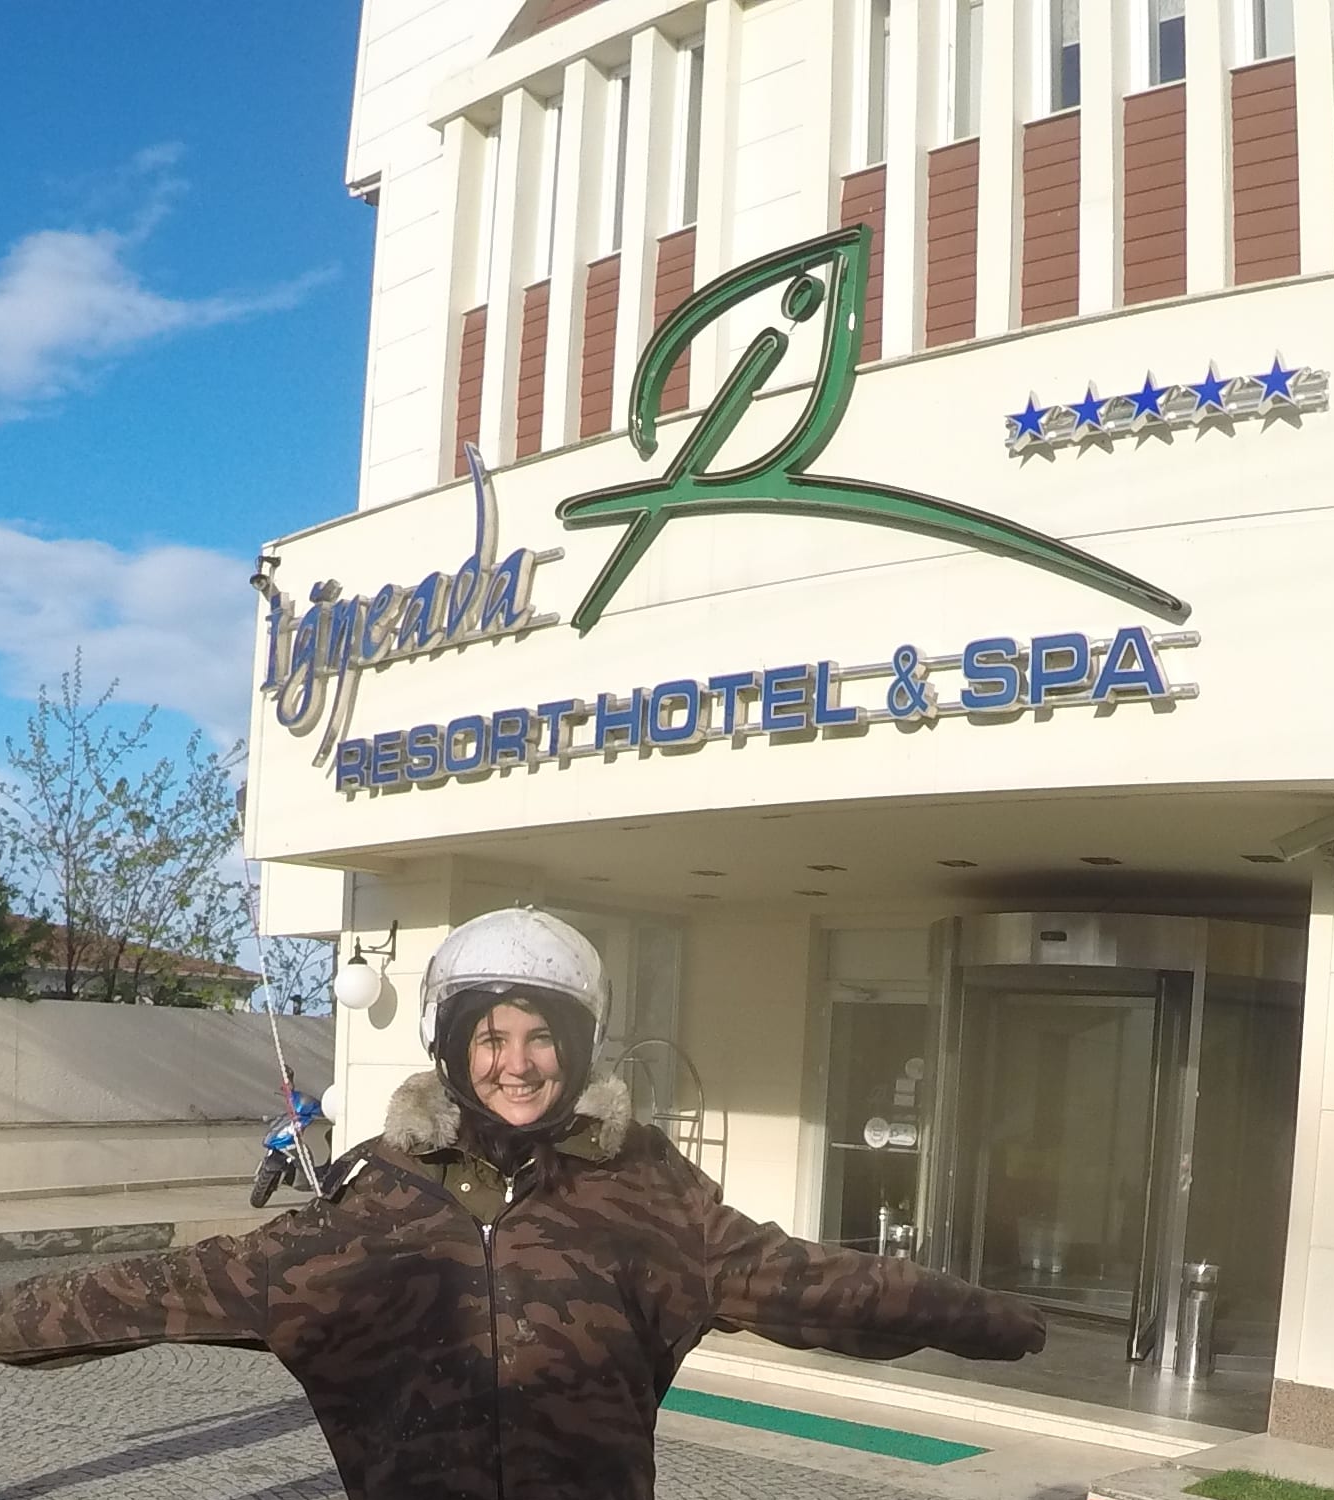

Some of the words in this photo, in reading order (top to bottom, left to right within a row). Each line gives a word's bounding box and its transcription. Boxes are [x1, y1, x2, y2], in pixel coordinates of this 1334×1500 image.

[335, 699, 578, 792] RESORT
[595, 660, 860, 750] HOTEL
[886, 643, 929, 718] &
[960, 626, 1167, 709] SPA
